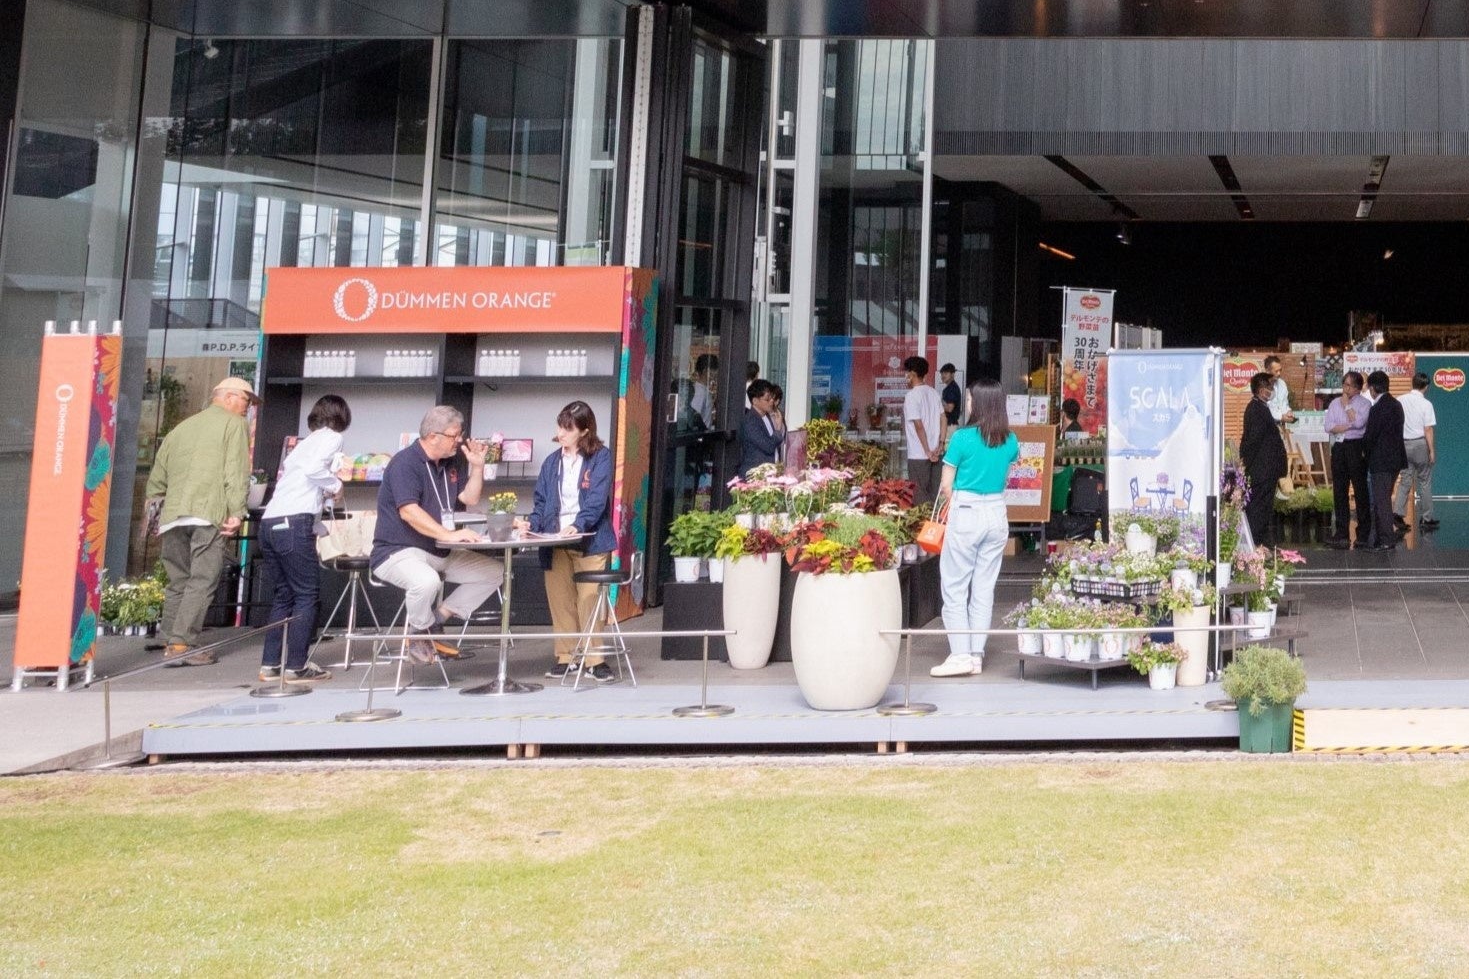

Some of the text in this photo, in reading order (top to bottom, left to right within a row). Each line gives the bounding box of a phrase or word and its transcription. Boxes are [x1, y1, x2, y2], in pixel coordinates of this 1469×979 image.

[381, 290, 467, 309] DÜMMEN
[202, 343, 259, 352] P.D.P.ライ
[1129, 386, 1190, 409] SCALA
